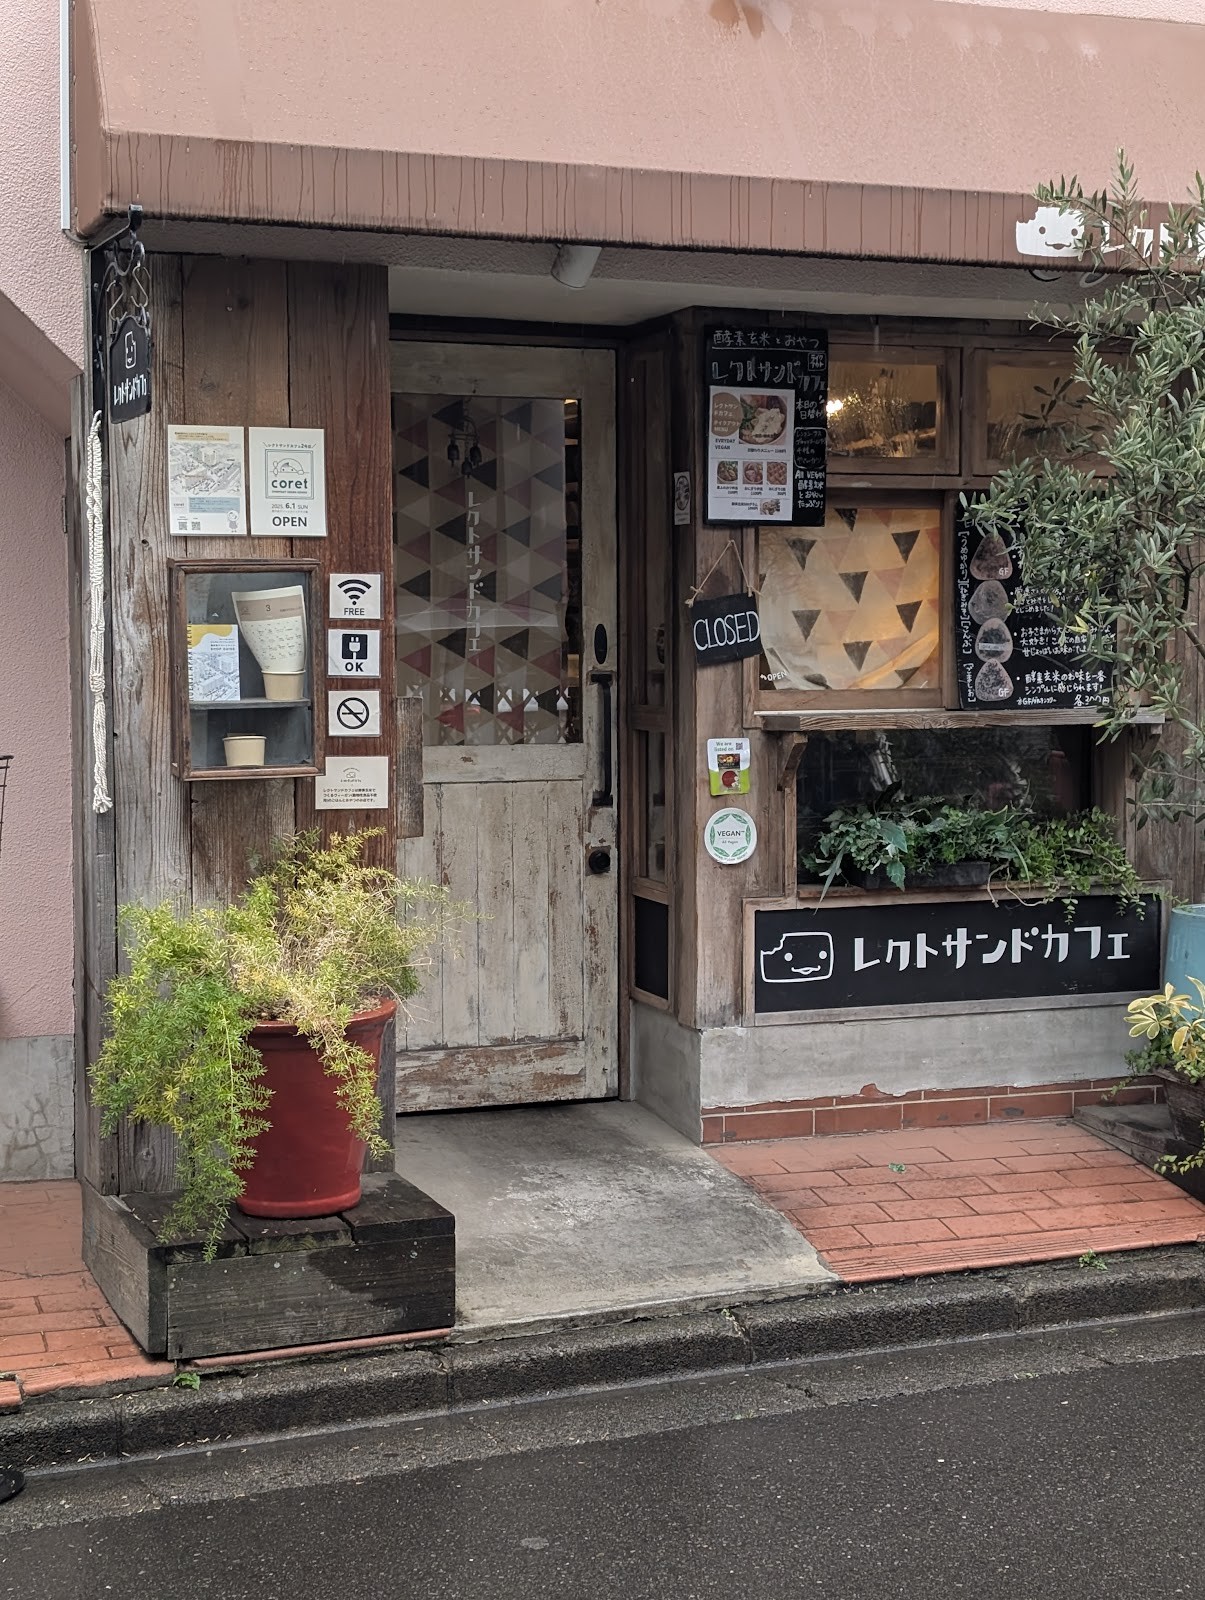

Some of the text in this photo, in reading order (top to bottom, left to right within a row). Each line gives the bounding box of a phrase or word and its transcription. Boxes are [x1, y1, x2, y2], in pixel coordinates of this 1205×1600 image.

[271, 478, 308, 489] coret
[272, 516, 308, 527] OPEN
[466, 492, 484, 652] レクトサンドカフェ
[998, 567, 1009, 577] GF
[265, 604, 271, 612] 3
[343, 607, 365, 616] FREE
[693, 611, 760, 651] CLOSED
[344, 661, 364, 672] OK
[767, 670, 787, 681] OPEN
[998, 687, 1010, 697] GF
[854, 924, 1131, 972] レクトサンドカフェ
